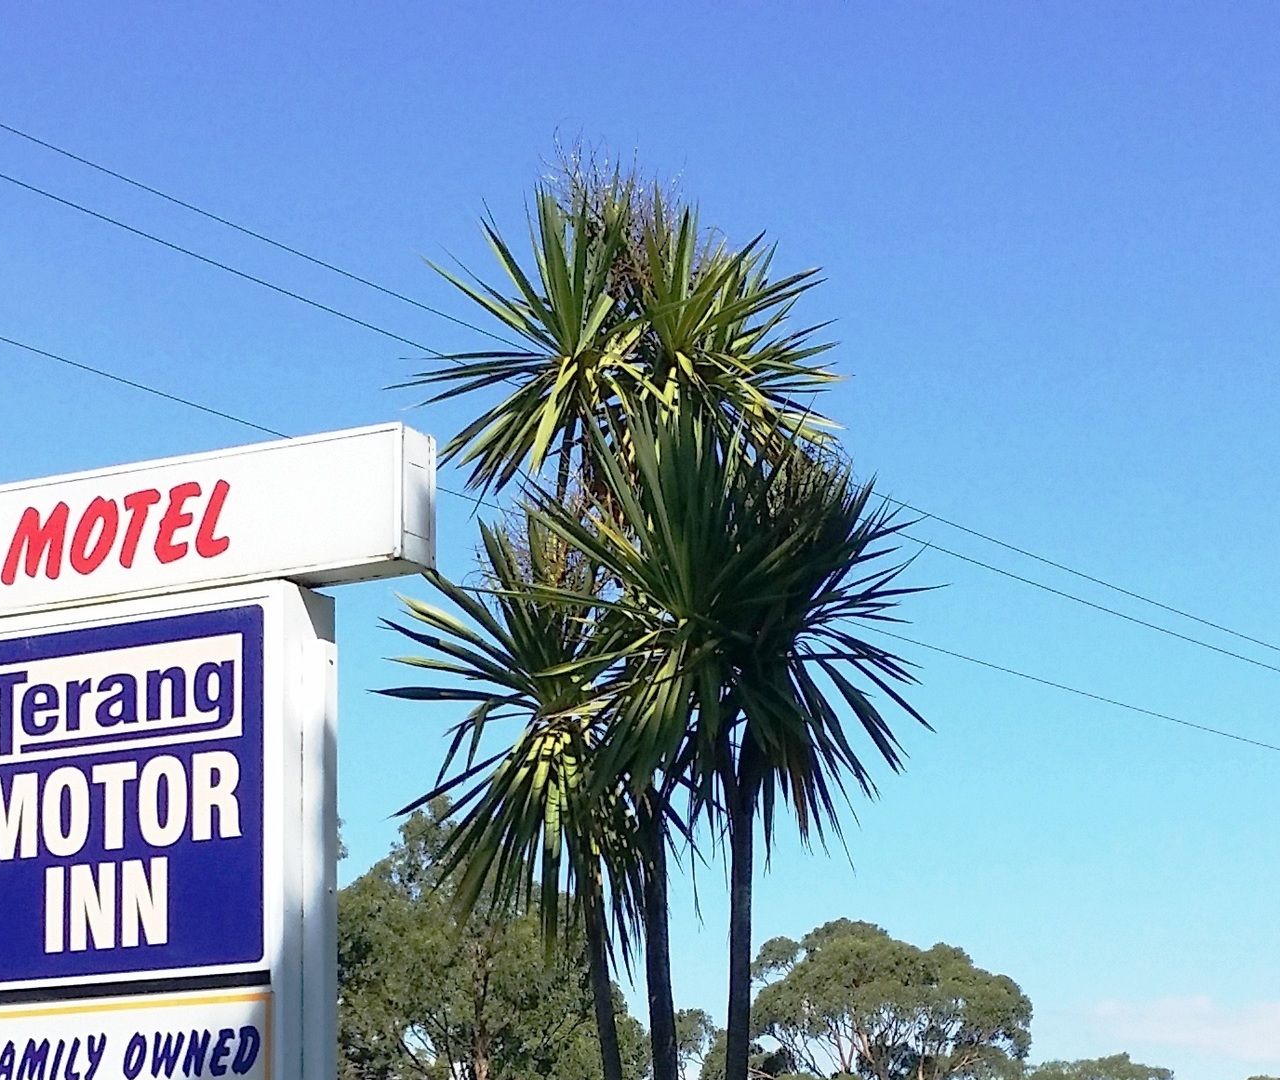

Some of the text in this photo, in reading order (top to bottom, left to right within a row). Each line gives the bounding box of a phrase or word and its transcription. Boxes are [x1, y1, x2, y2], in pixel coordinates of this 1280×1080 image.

[1, 479, 230, 586] MOTEL
[44, 856, 169, 954] INN
[122, 1024, 261, 1080] OWNED
